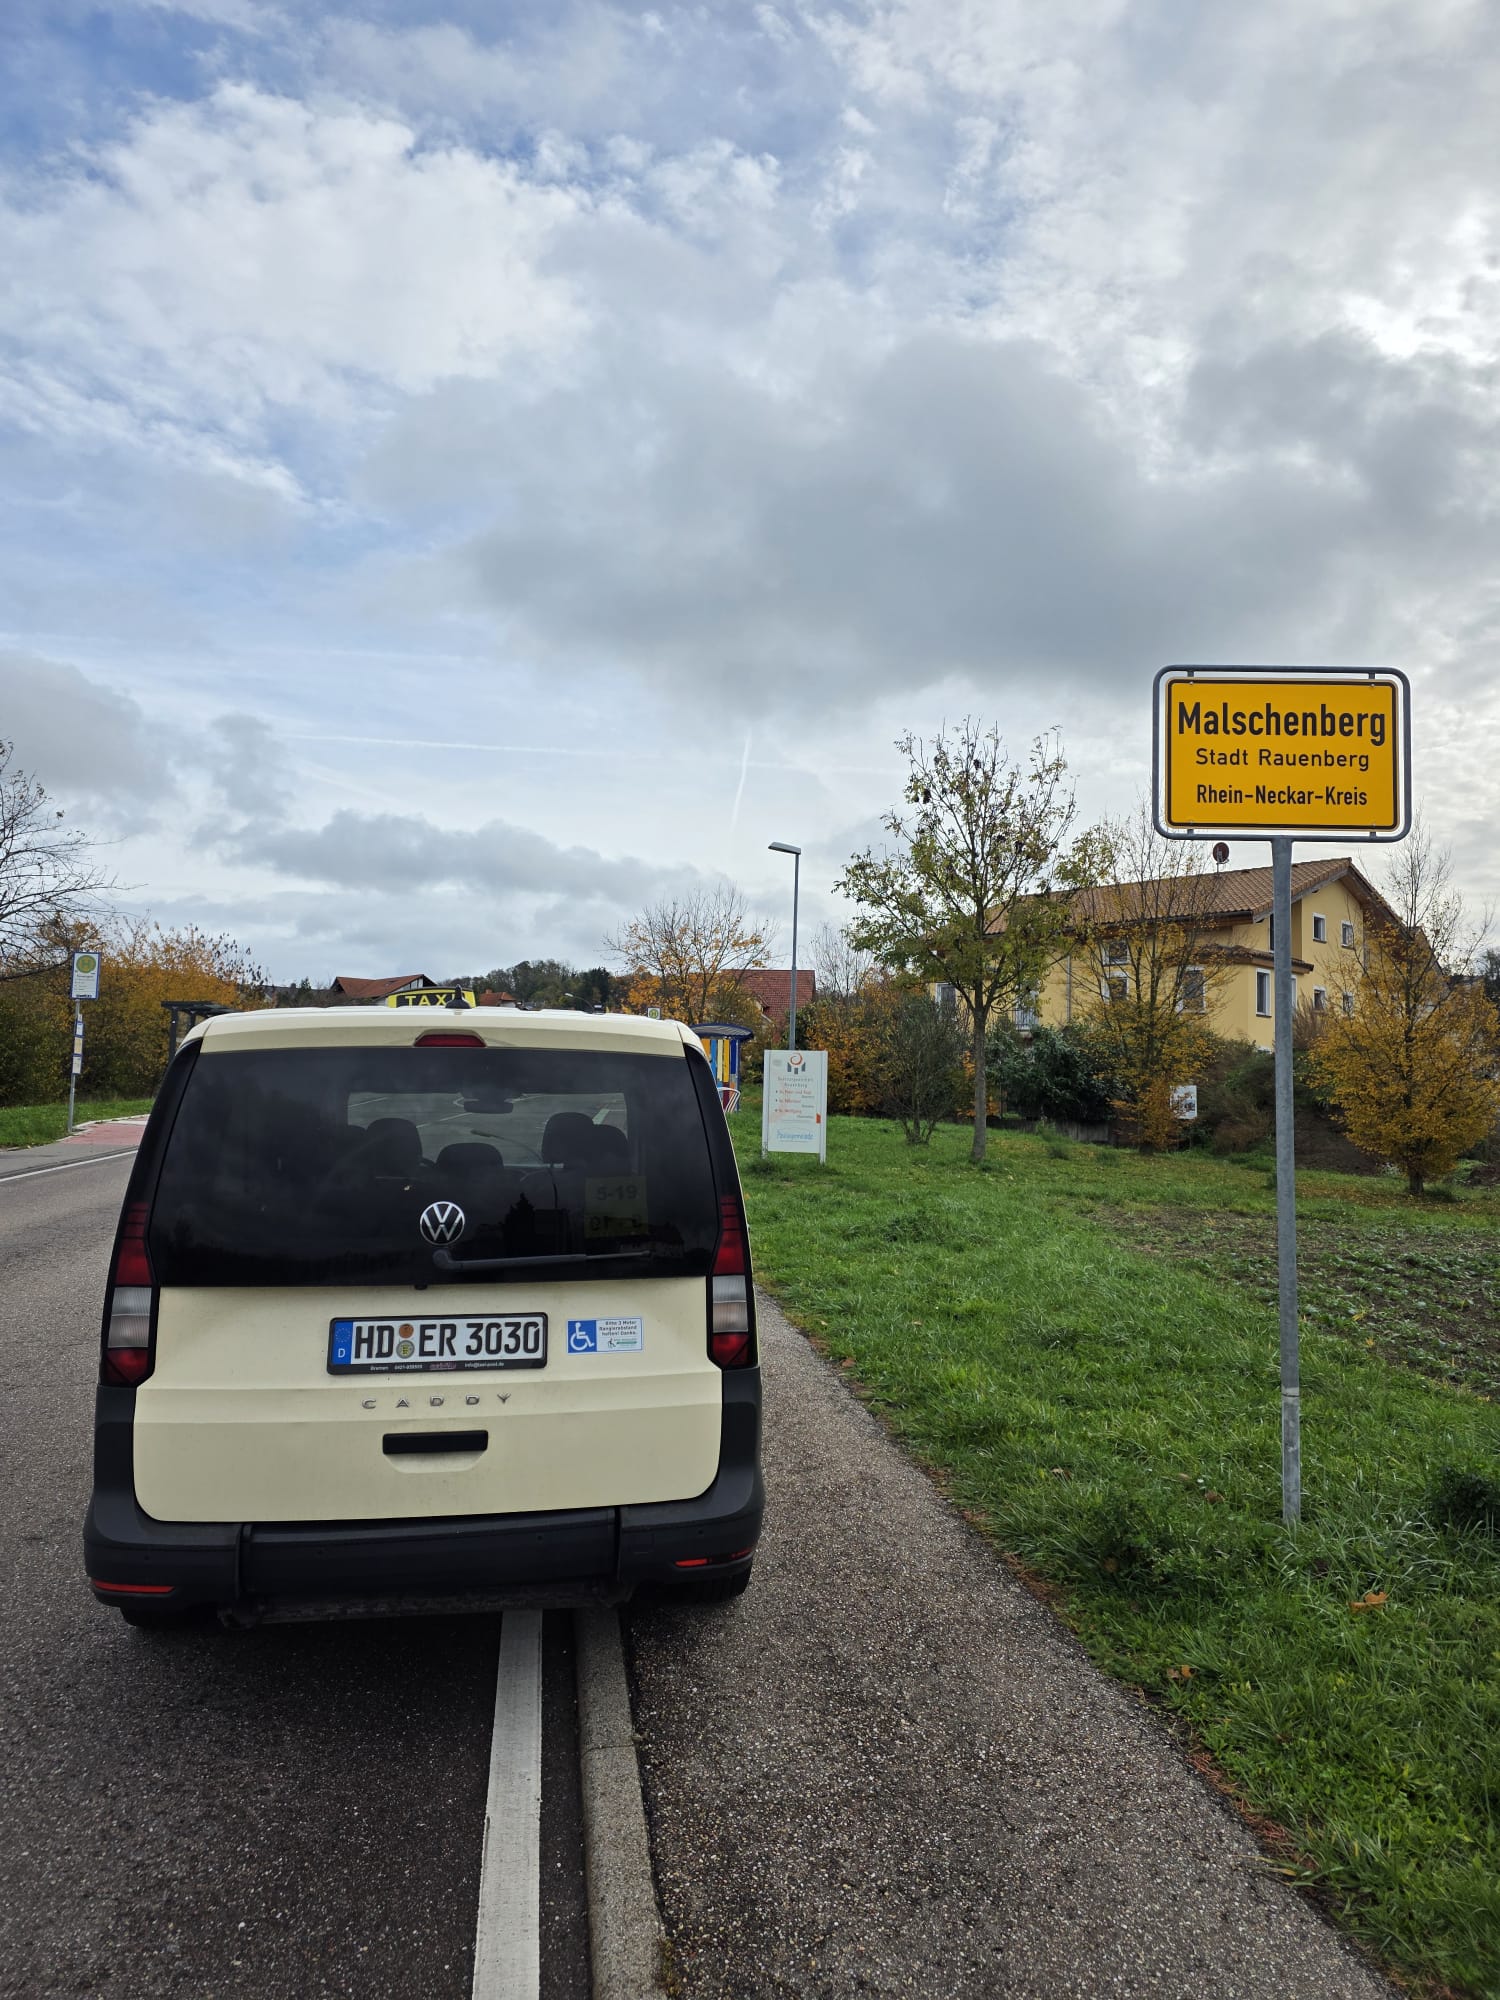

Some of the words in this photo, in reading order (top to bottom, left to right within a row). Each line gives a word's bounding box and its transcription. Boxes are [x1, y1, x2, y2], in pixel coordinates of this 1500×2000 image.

[1178, 701, 1385, 747] Malschenberg
[1195, 748, 1249, 766] Stadt
[1258, 748, 1369, 772] Rauenberg
[1196, 784, 1367, 807] Rhein-Neckar-Kreis
[338, 1347, 346, 1358] D
[354, 1325, 395, 1359] HD
[418, 1323, 457, 1357] ER
[465, 1321, 540, 1355] 3030
[361, 1392, 512, 1410] CADDY
